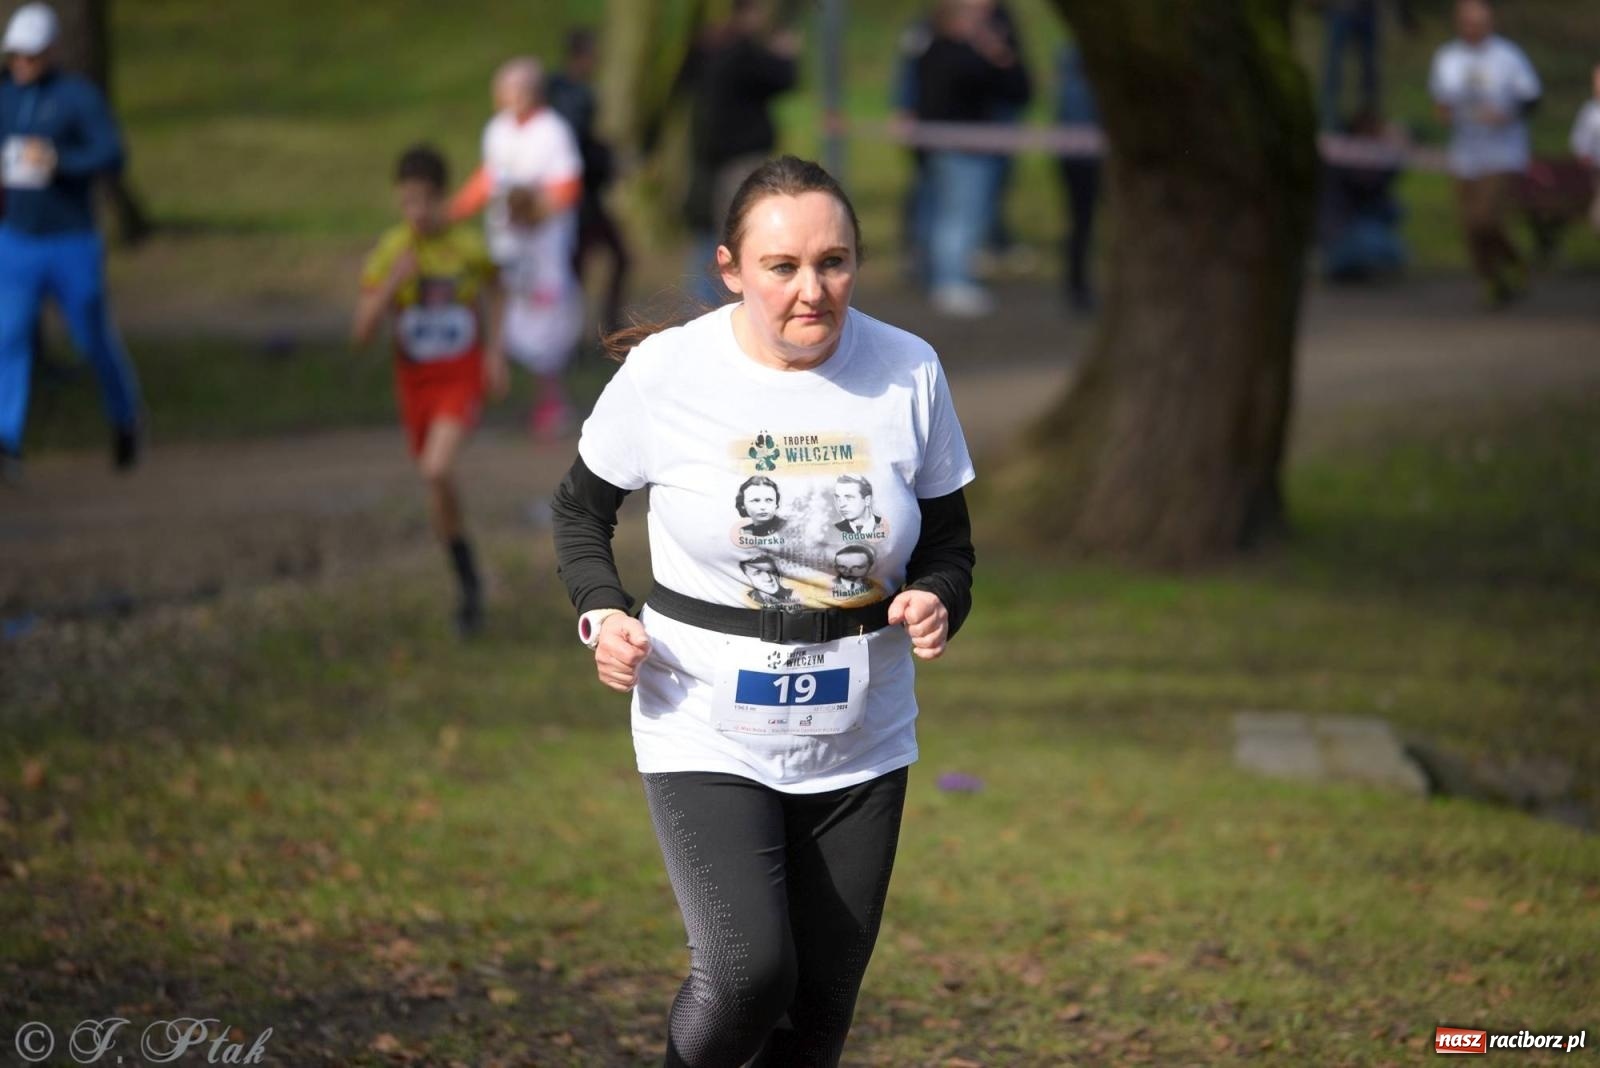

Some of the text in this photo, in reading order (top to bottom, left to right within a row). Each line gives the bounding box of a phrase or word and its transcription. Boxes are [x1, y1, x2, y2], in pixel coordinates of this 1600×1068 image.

[783, 435, 819, 446] TROPEM
[785, 444, 853, 463] WILCZYM
[738, 535, 785, 545] Stolarska
[841, 530, 886, 541] Rodowicz
[786, 653, 825, 667] WILCZYM
[773, 673, 817, 704] 19
